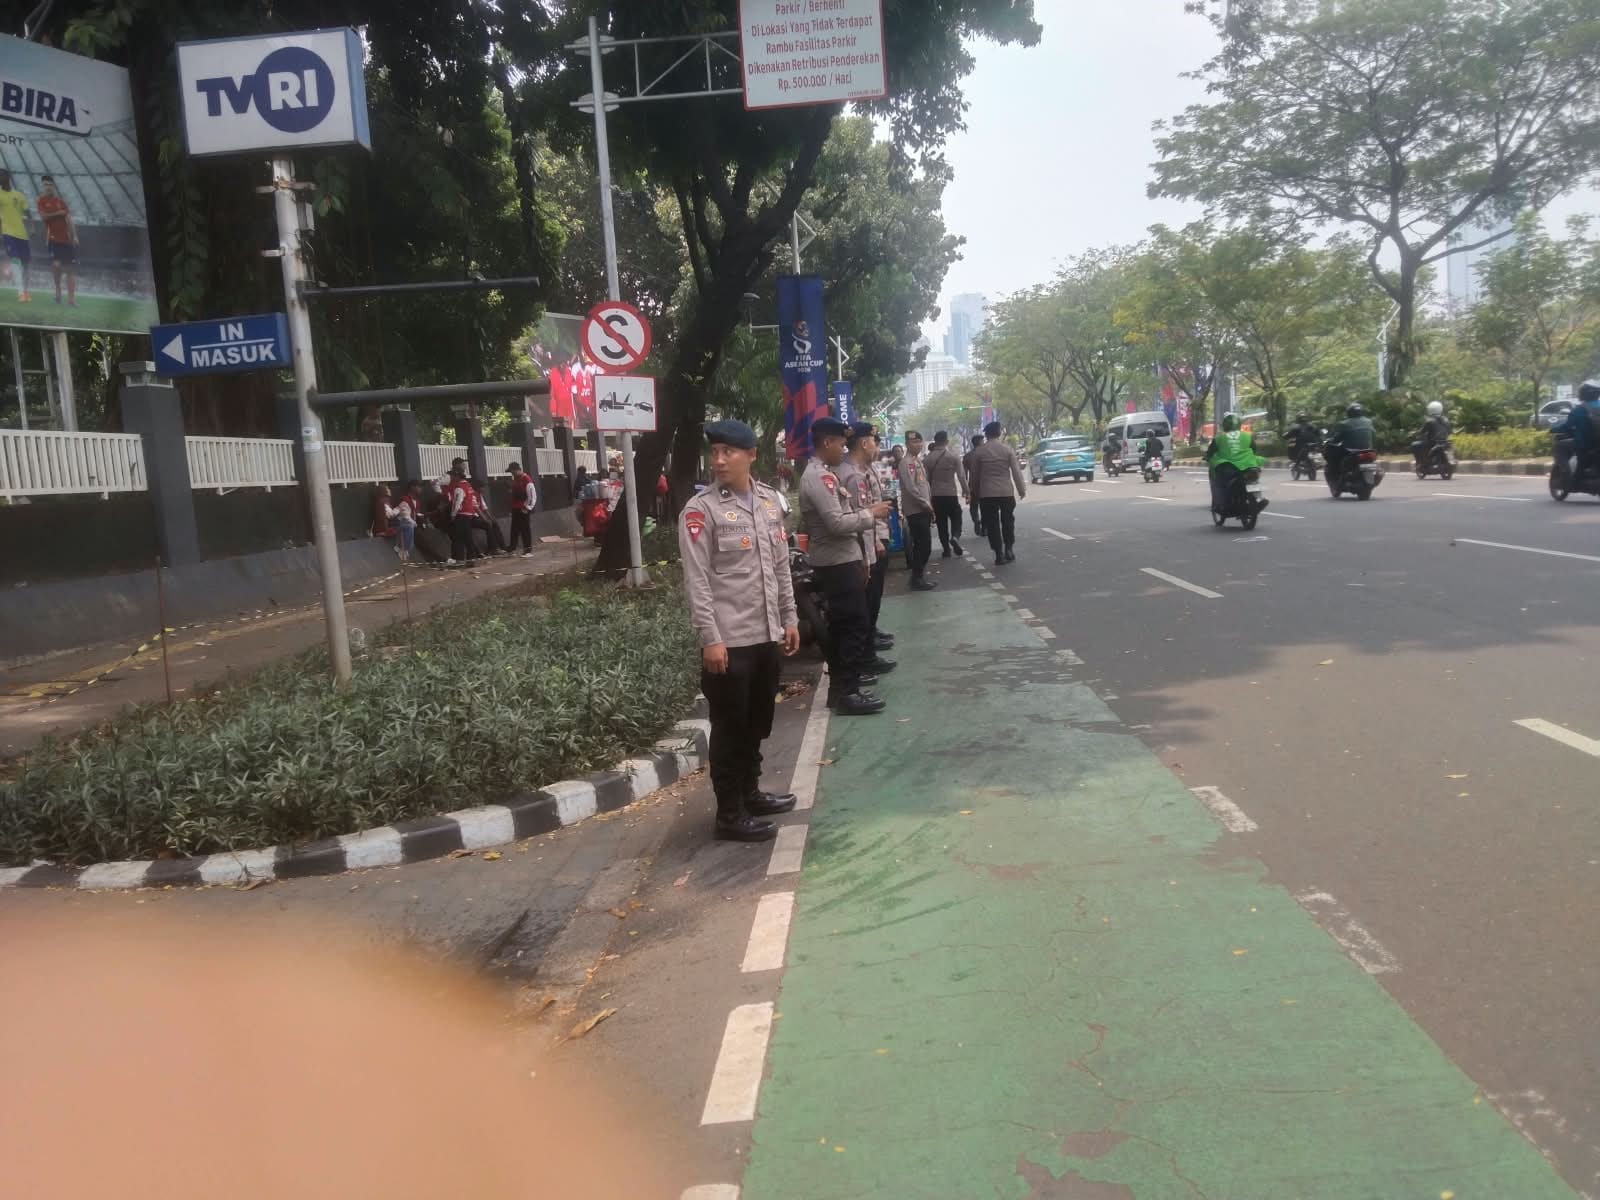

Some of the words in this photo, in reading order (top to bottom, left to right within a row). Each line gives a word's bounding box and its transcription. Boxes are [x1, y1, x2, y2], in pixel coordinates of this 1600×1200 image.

[776, 1, 801, 15] Parkir
[808, 0, 845, 12] Berhenti
[751, 25, 760, 37] Di
[761, 23, 788, 36] Lokasi
[789, 21, 810, 35] Yang
[811, 18, 834, 31] Tidak
[836, 15, 873, 30] Terdapat
[766, 41, 794, 55] Rambu
[795, 37, 831, 51] Fasilitas
[832, 34, 857, 48] Parkir
[748, 60, 791, 75] Dikenakan
[792, 56, 829, 71] Retribusi
[831, 52, 880, 67] Penderekan
[196, 69, 319, 116] TVRI
[778, 78, 791, 93] Rp.
[792, 75, 827, 89] 500.000
[835, 71, 852, 85] Hari
[2, 81, 78, 127] BIRA
[219, 322, 244, 341] IN
[600, 314, 629, 359] S
[191, 343, 276, 368] MASUK
[784, 361, 809, 369] ASEAN
[809, 359, 824, 367] CUP
